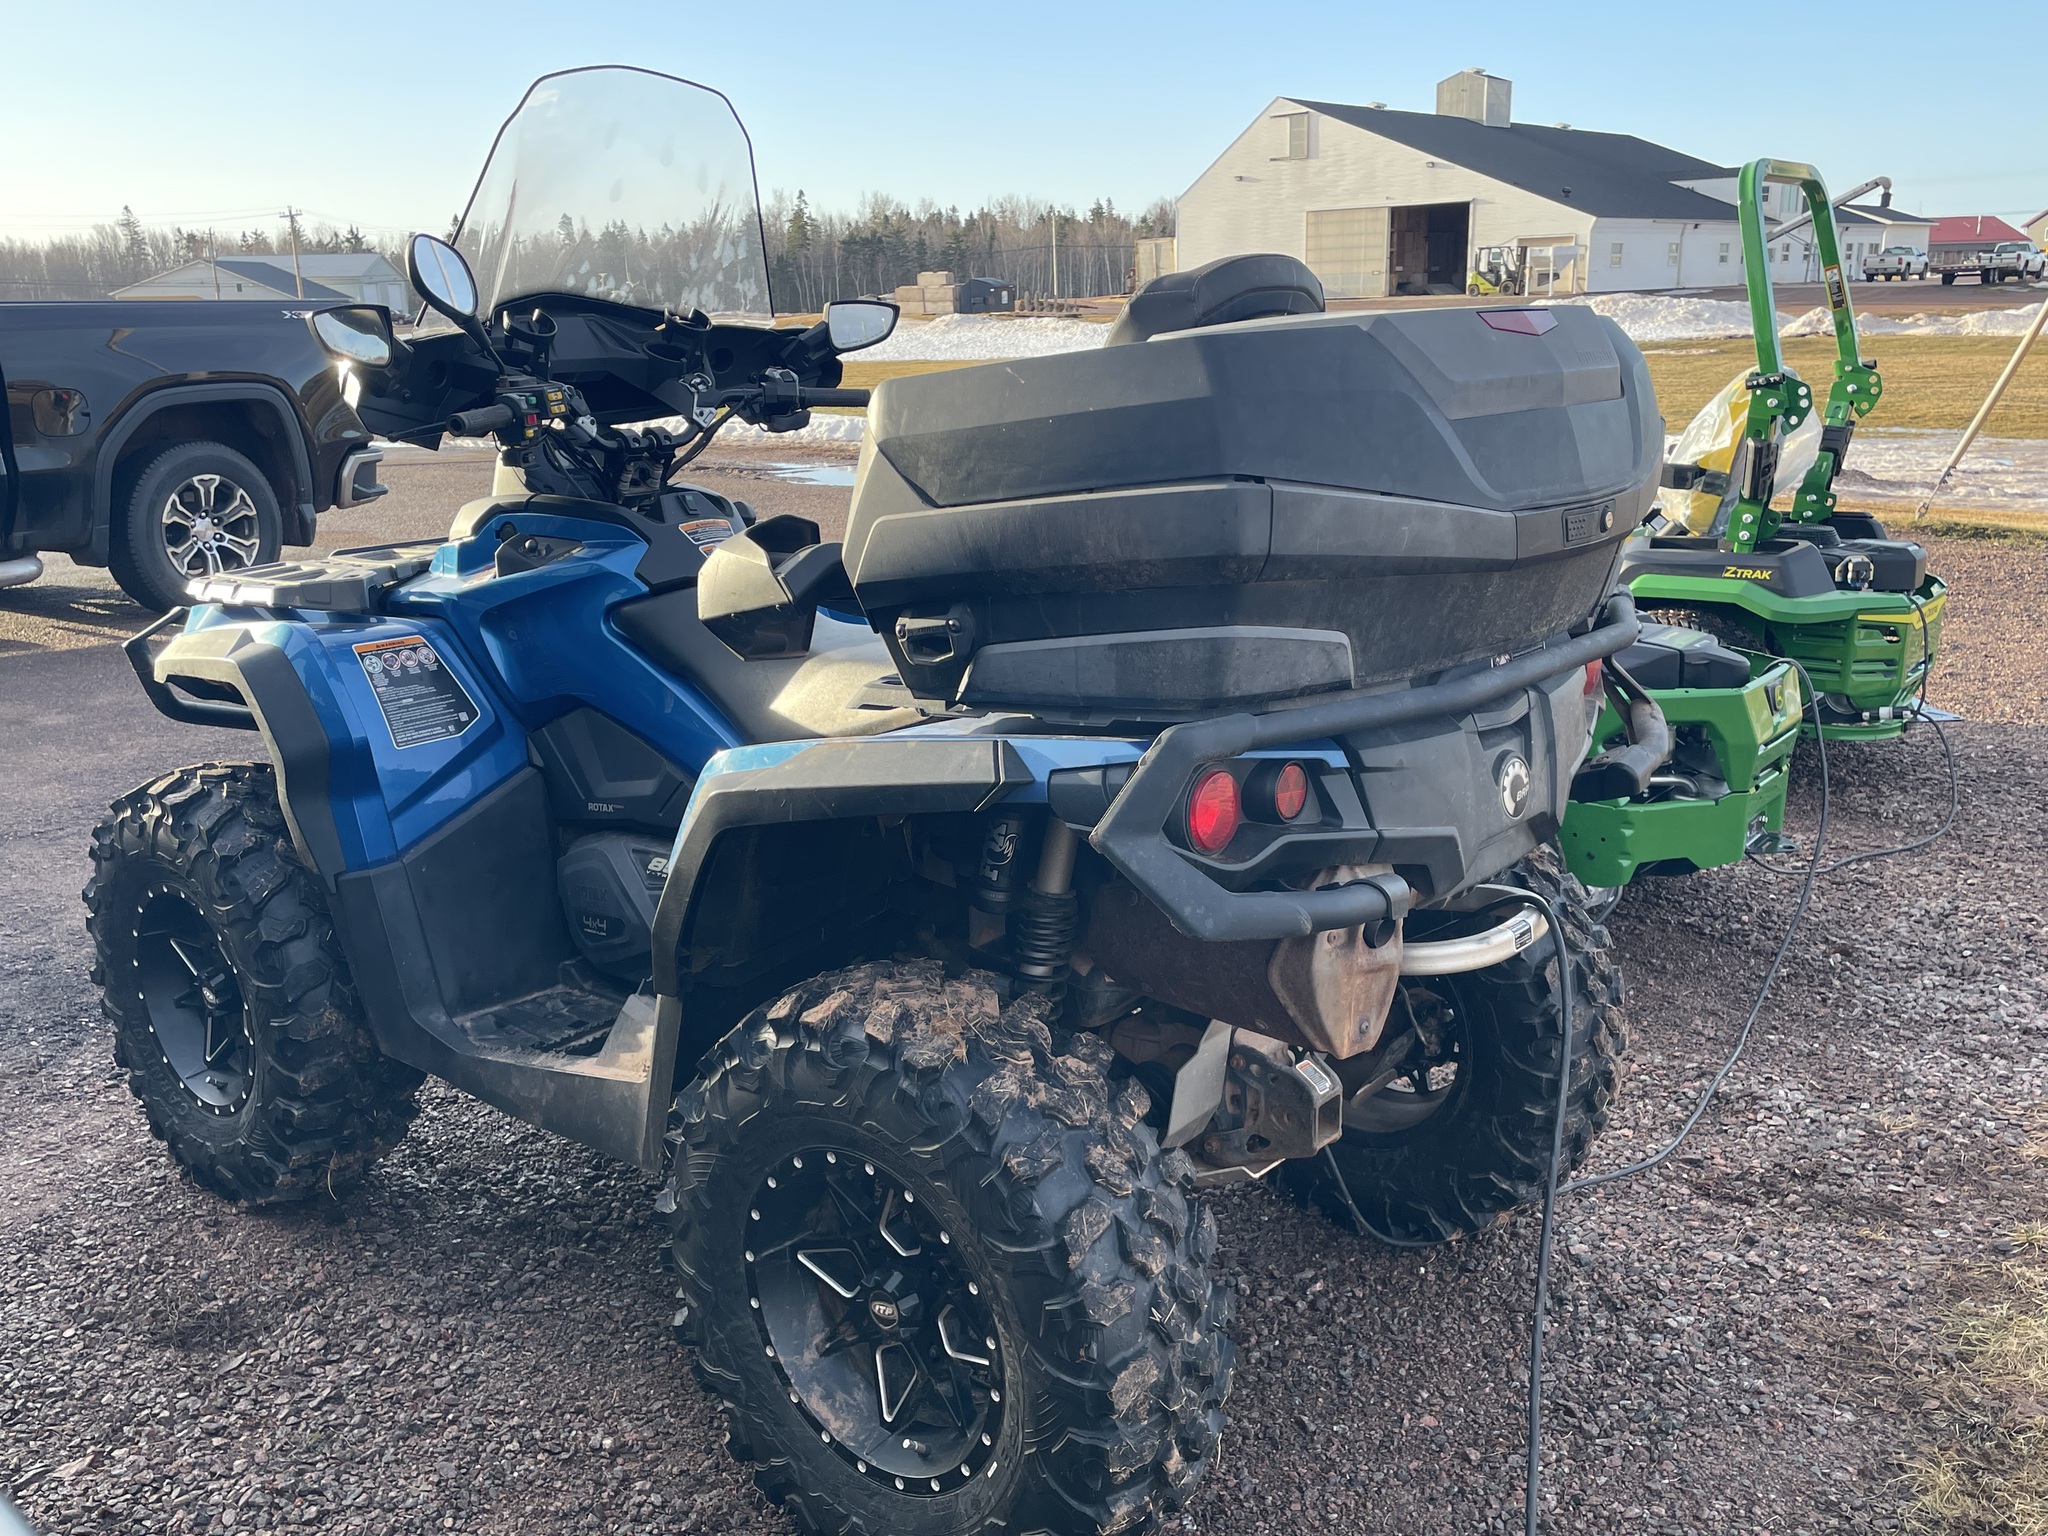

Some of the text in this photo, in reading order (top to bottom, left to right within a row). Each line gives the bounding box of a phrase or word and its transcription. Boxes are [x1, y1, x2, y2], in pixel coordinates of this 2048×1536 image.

[1723, 566, 1773, 581] ZTRAK
[588, 802, 614, 813] ROTAX
[979, 822, 1019, 881] FOX
[583, 915, 607, 931] 4x4
[875, 1304, 893, 1316] ITP
